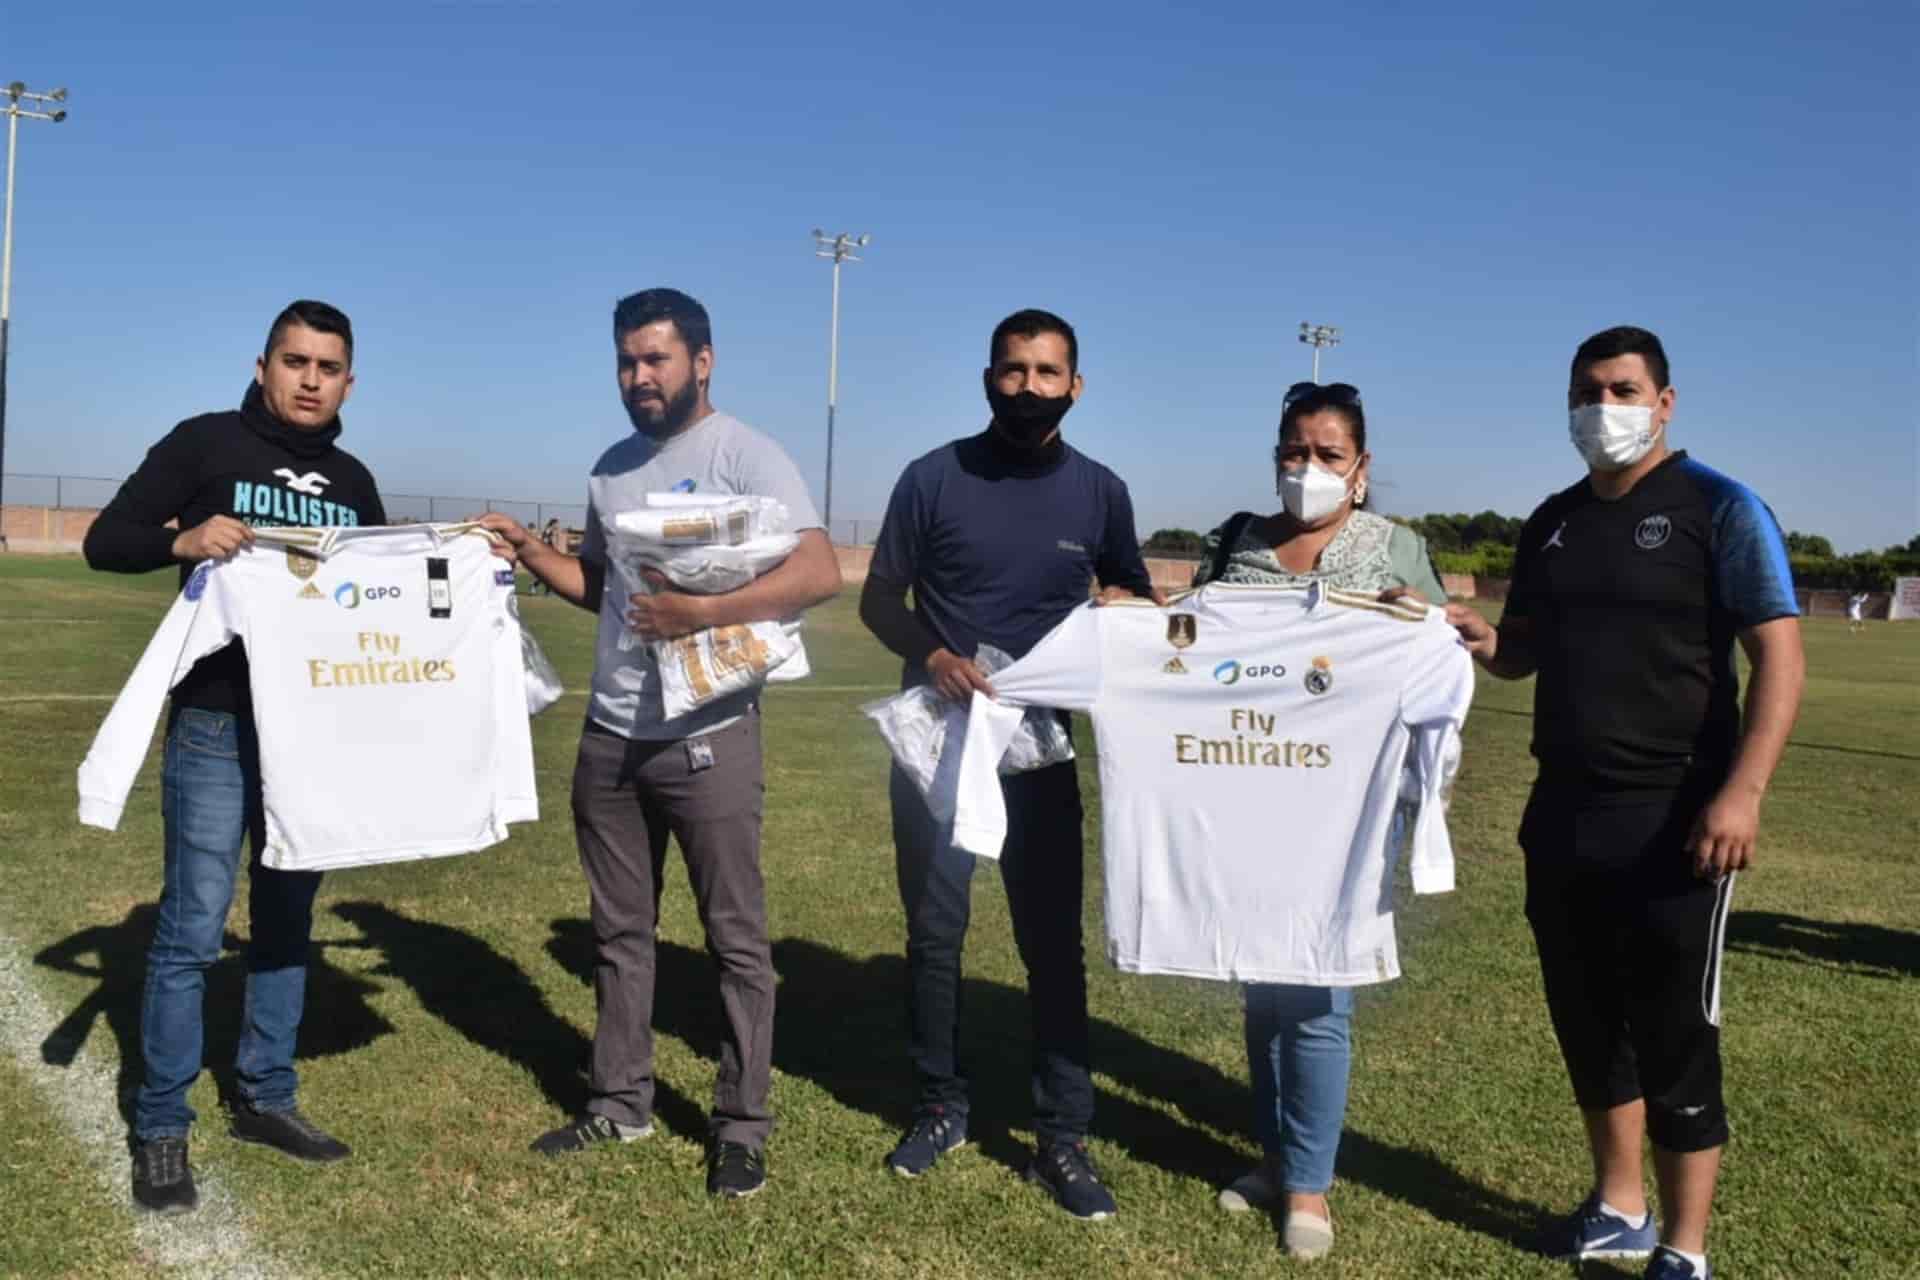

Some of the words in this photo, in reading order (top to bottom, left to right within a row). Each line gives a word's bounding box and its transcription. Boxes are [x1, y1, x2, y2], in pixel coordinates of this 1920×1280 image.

[365, 586, 401, 600] GPO
[358, 632, 400, 656] Fly
[307, 656, 456, 688] Emirates
[1245, 664, 1287, 678] GPO
[1231, 708, 1275, 736] Fly
[1174, 734, 1331, 768] Emirates
